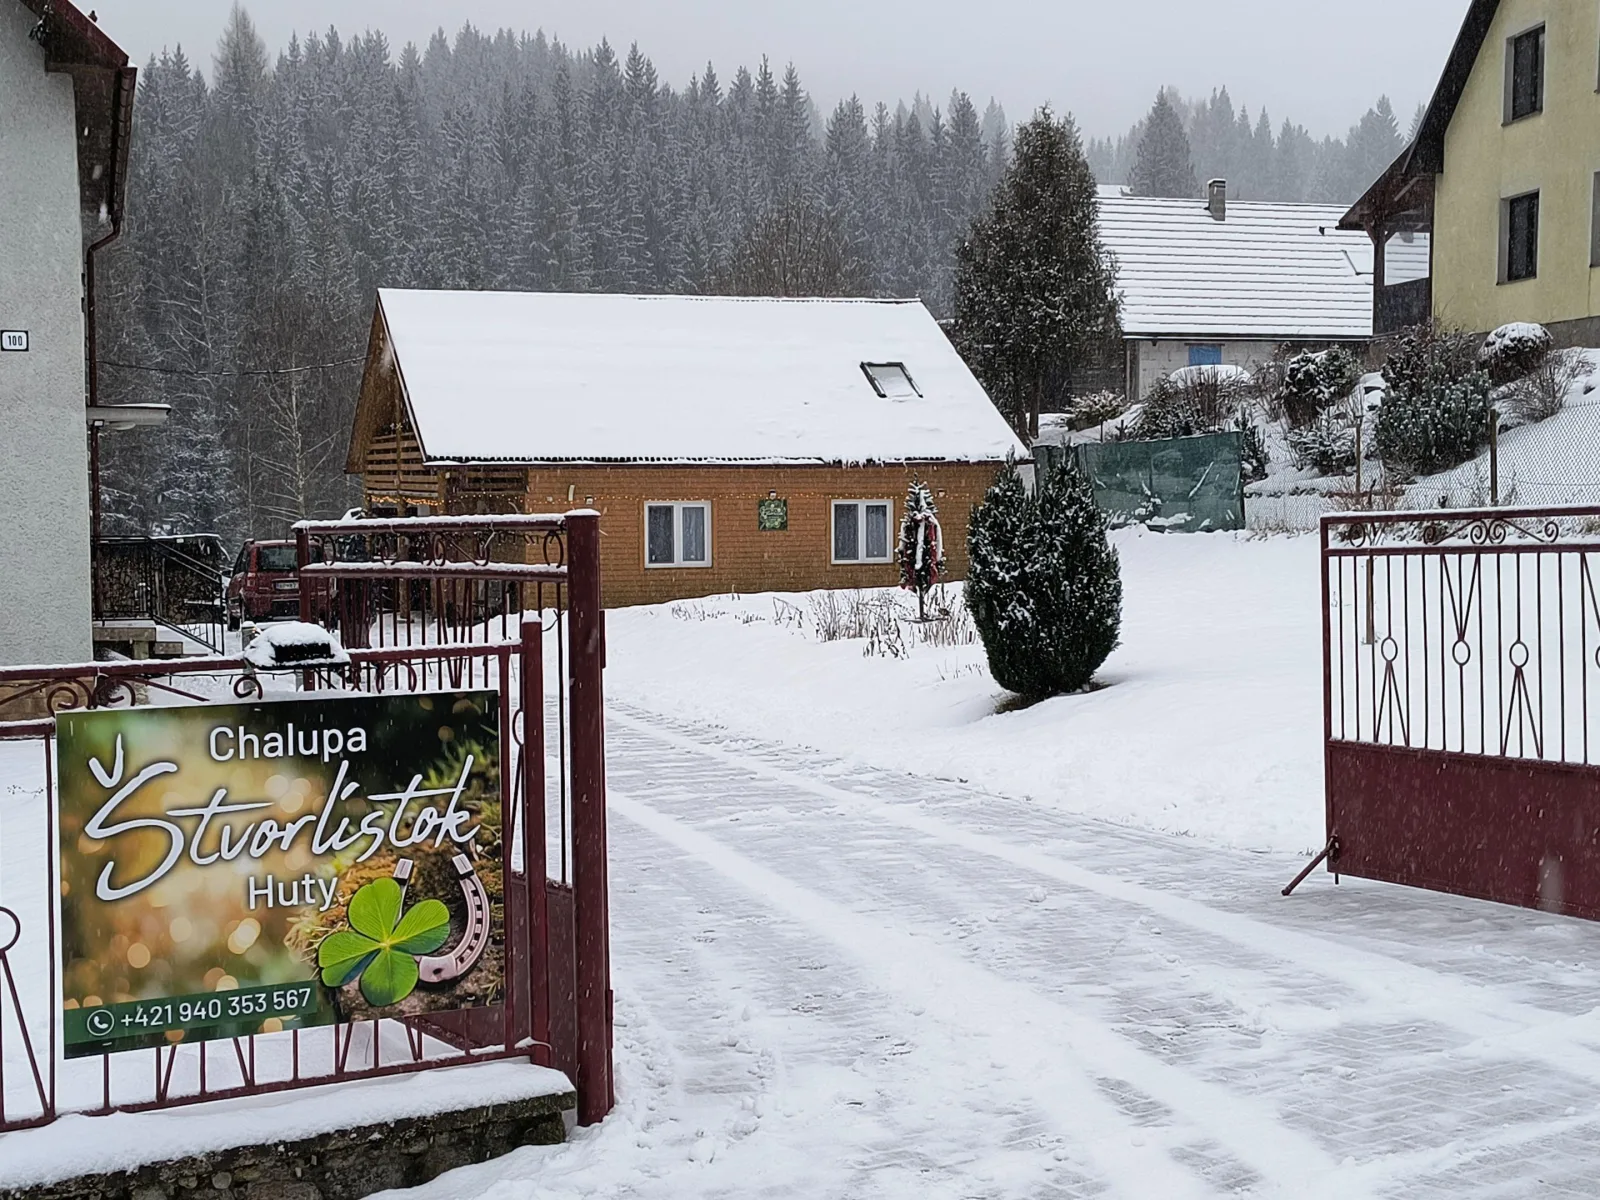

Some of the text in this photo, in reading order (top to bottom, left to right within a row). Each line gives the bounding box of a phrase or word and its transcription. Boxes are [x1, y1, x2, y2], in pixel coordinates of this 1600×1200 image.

[8, 335, 23, 346] 100
[209, 723, 367, 762] Chalupa
[84, 733, 481, 901] Štvorlístok
[248, 874, 338, 912] Huty
[120, 987, 311, 1027] +421 940 353 567
